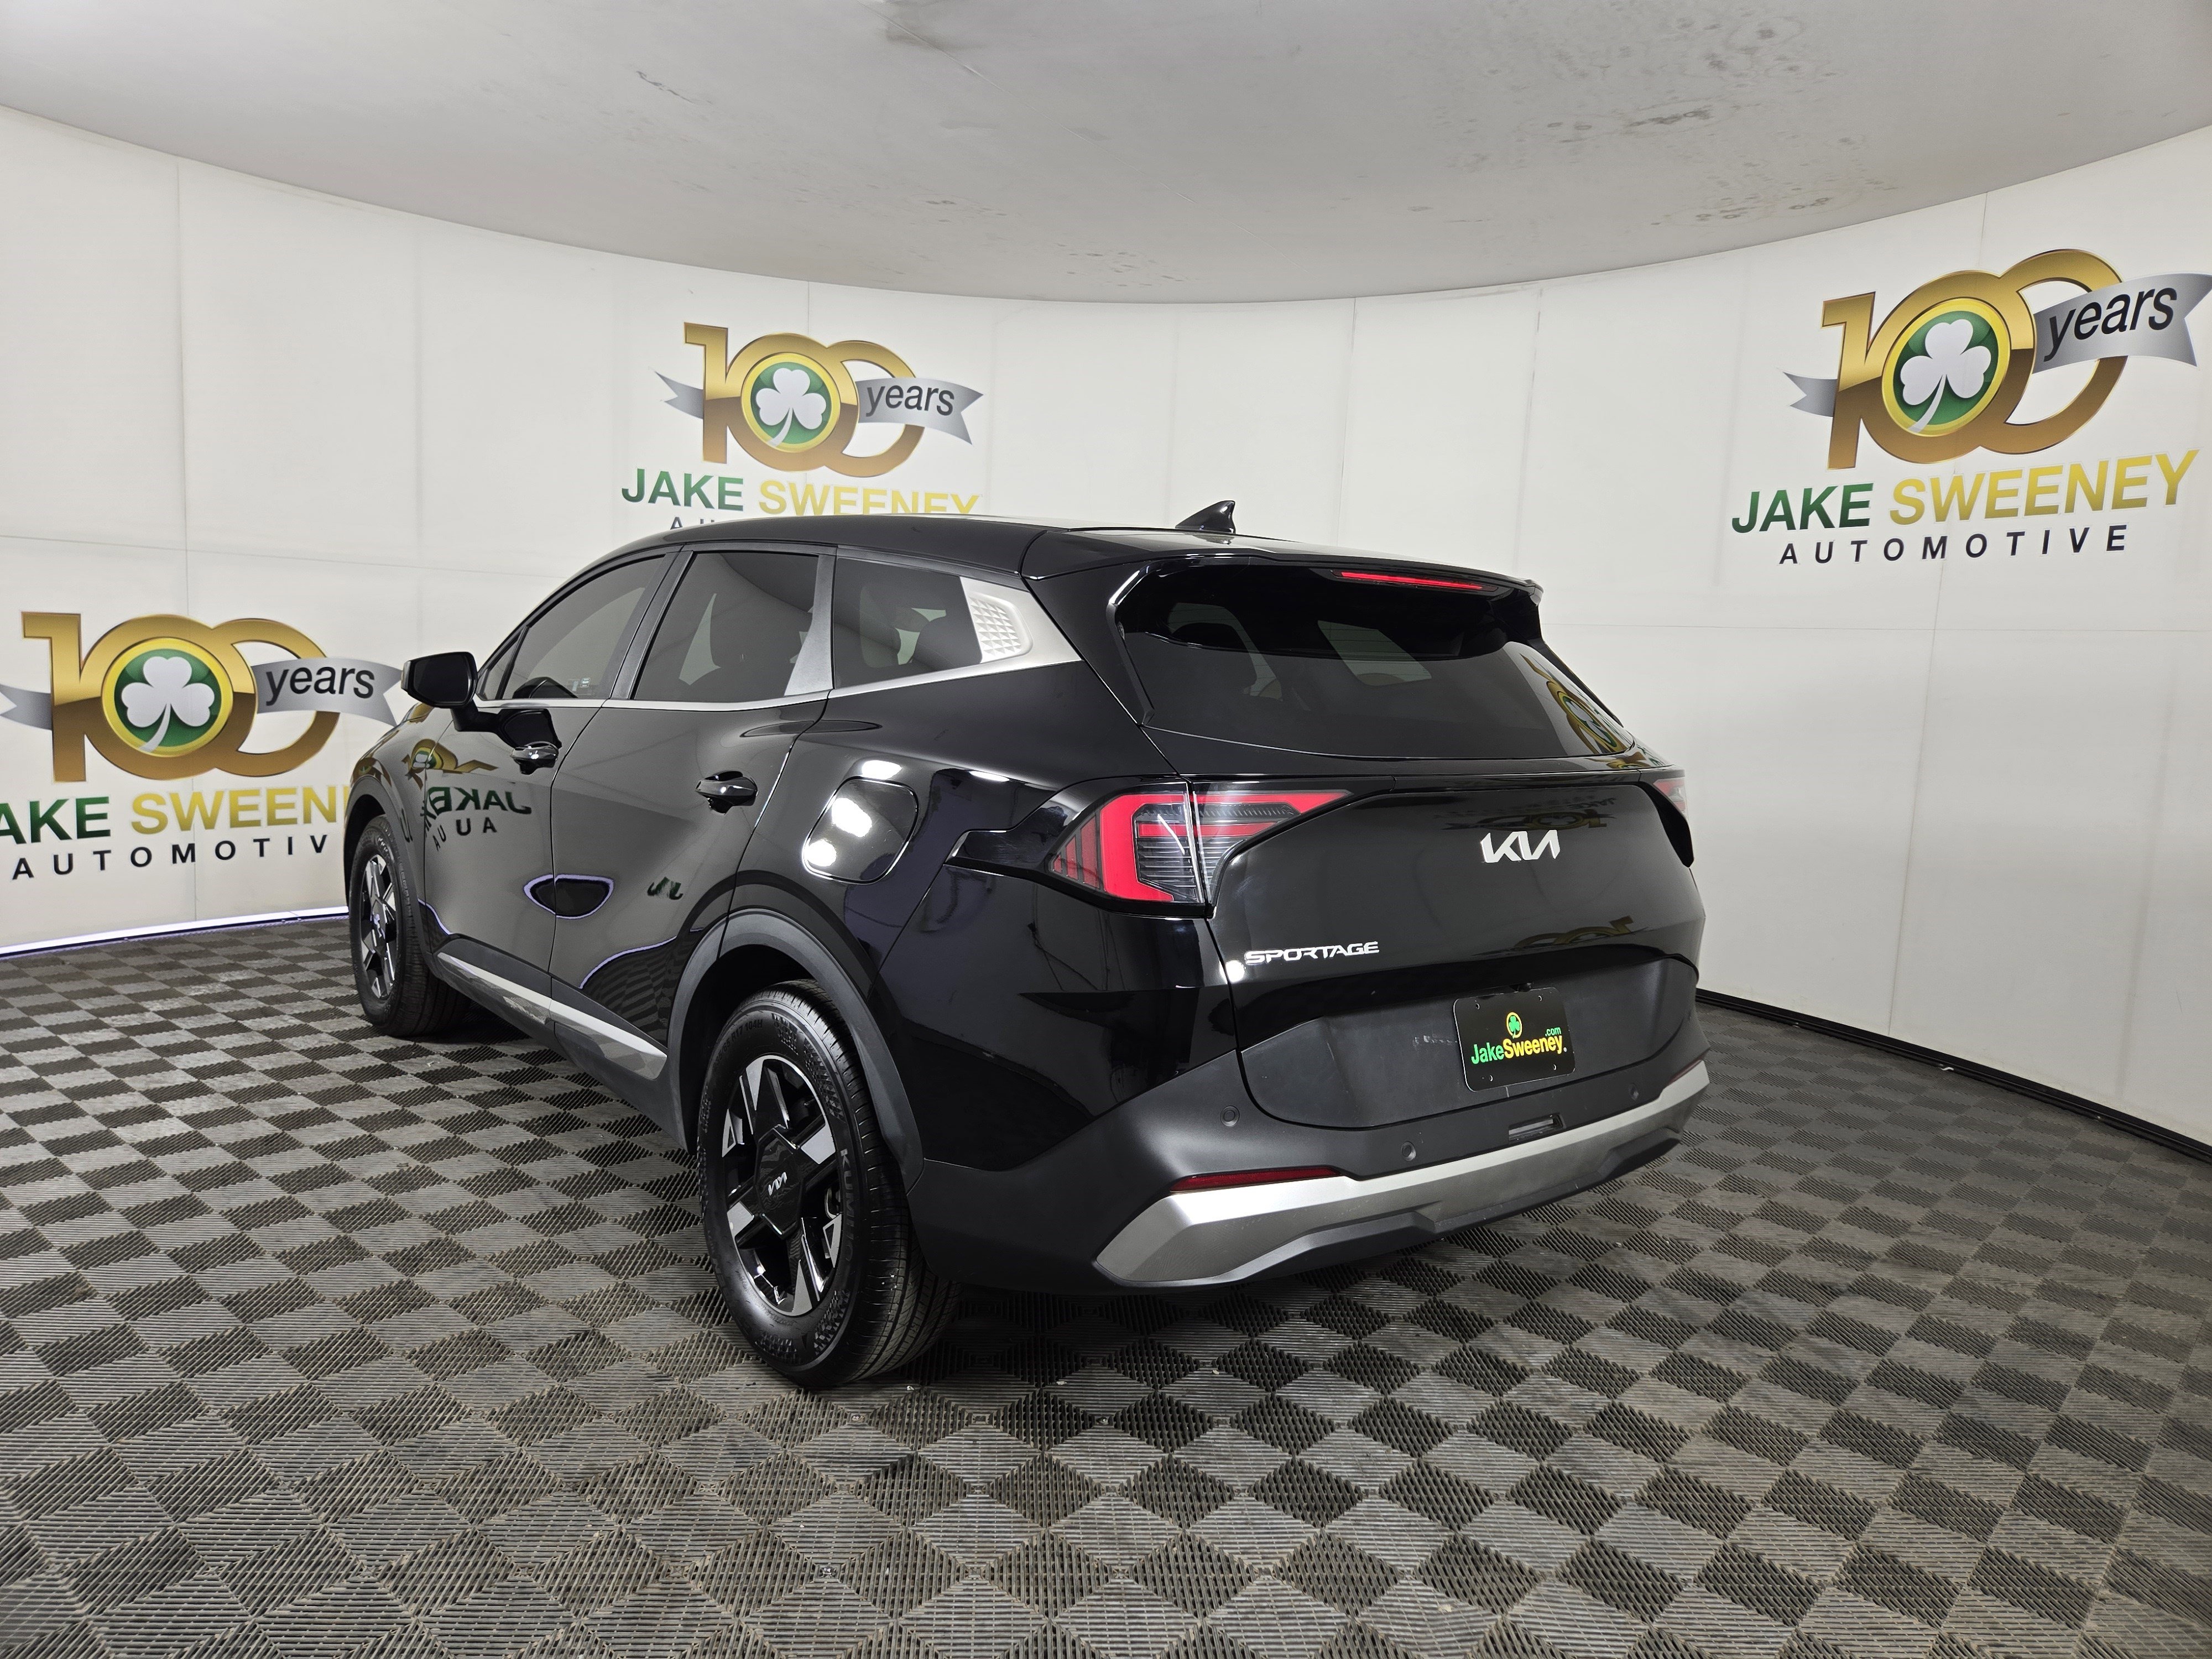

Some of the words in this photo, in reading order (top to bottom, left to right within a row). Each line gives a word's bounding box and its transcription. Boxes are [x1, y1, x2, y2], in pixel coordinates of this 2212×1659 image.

[1821, 248, 2128, 470] 100
[2043, 286, 2178, 363] years
[684, 322, 926, 478] 100
[864, 384, 955, 417] years
[621, 468, 744, 512] JAKE
[1731, 482, 1874, 534] JAKE
[1890, 449, 2200, 525] SWEENEY
[1779, 525, 2127, 565] AUTOMOTIVE
[21, 612, 340, 782] 100
[265, 666, 375, 706] years
[0, 796, 111, 845] AKE
[131, 785, 350, 835] SWEEN
[12, 834, 327, 880] AUTOMOTIV
[1480, 830, 1561, 863] KIA
[1244, 941, 1379, 965] SPORTAGE
